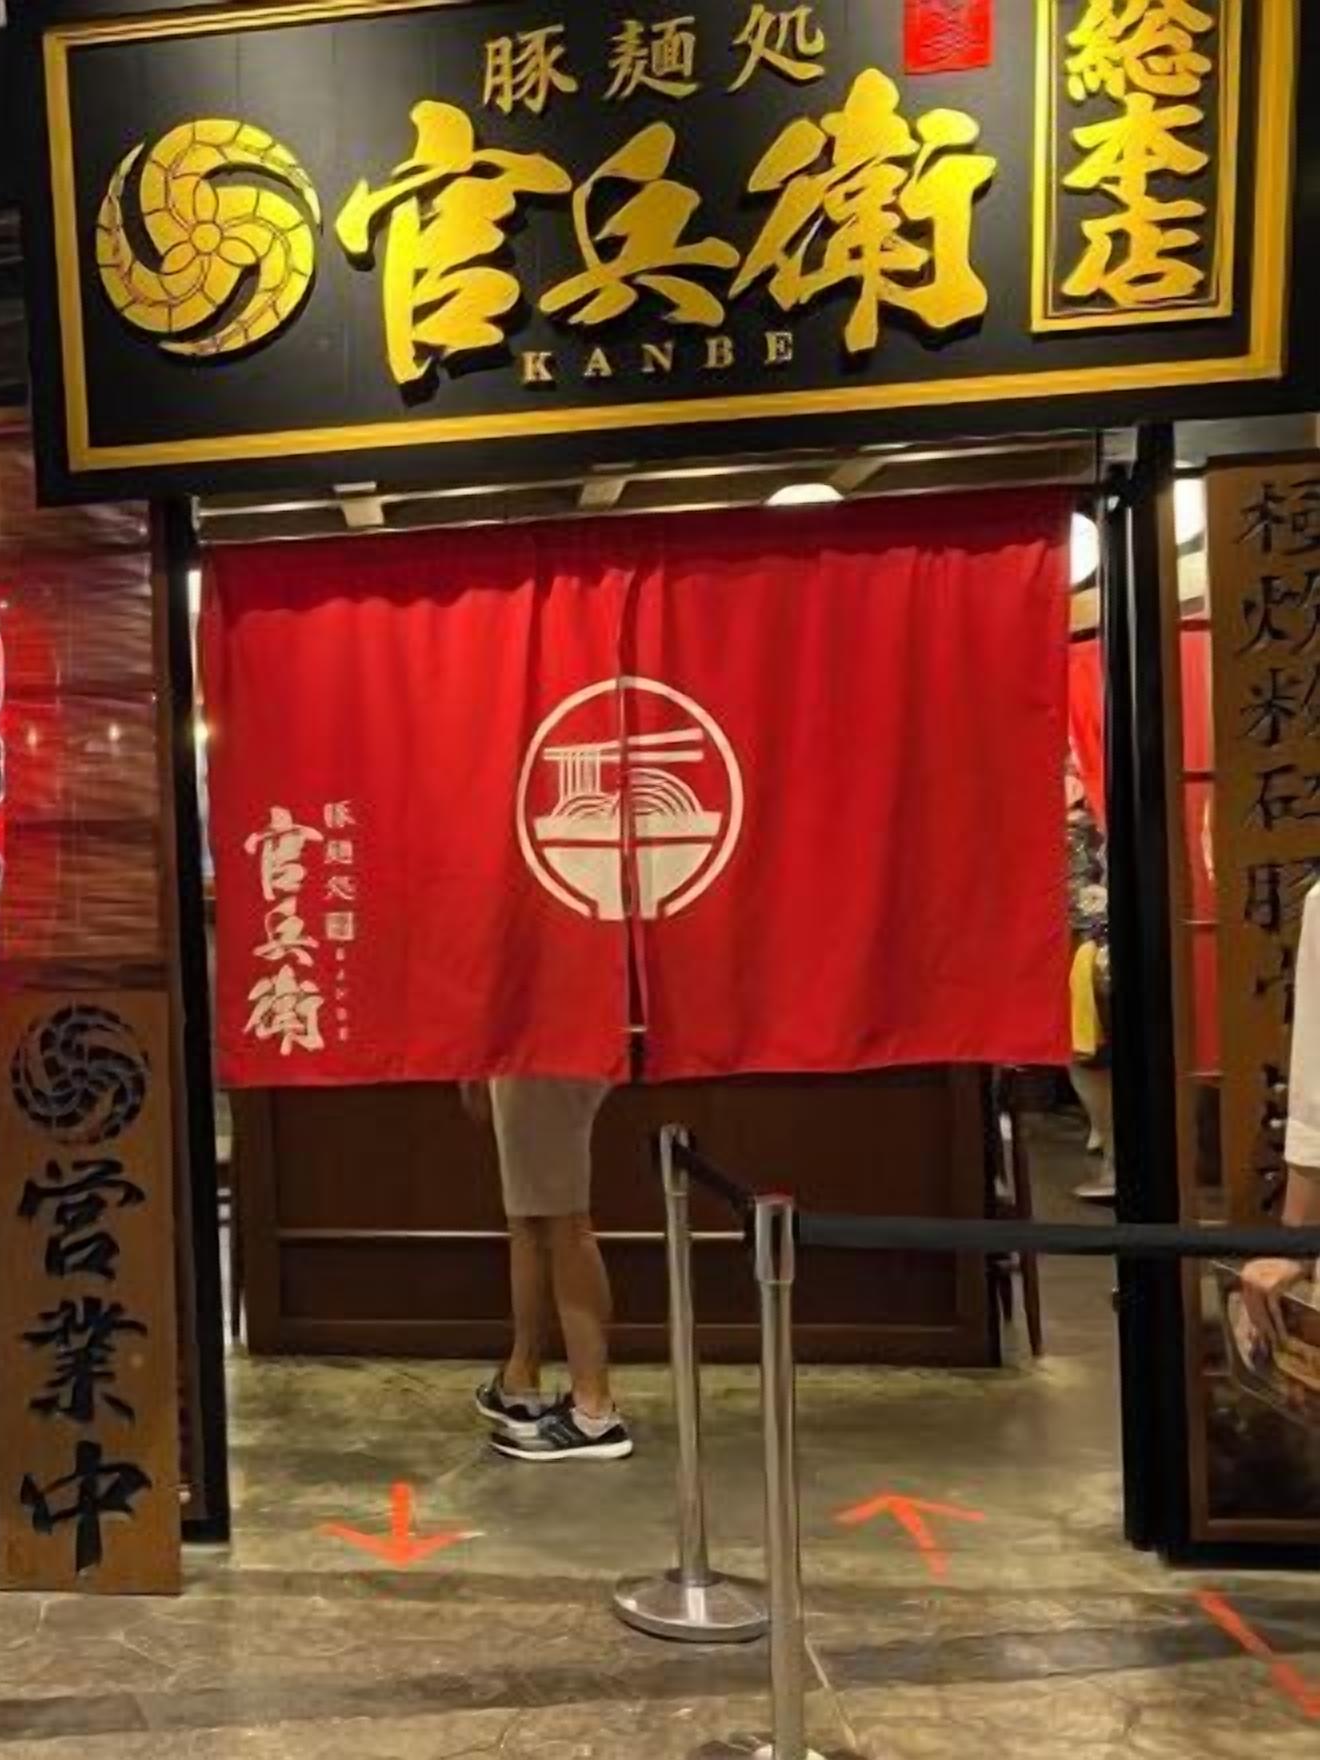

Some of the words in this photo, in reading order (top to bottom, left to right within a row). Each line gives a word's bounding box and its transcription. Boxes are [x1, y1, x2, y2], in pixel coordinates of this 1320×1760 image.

[335, 69, 998, 386] 官兵衛
[522, 330, 793, 381] KANBE
[243, 805, 325, 1056] 官兵衛
[17, 1158, 154, 1577] 営業中
